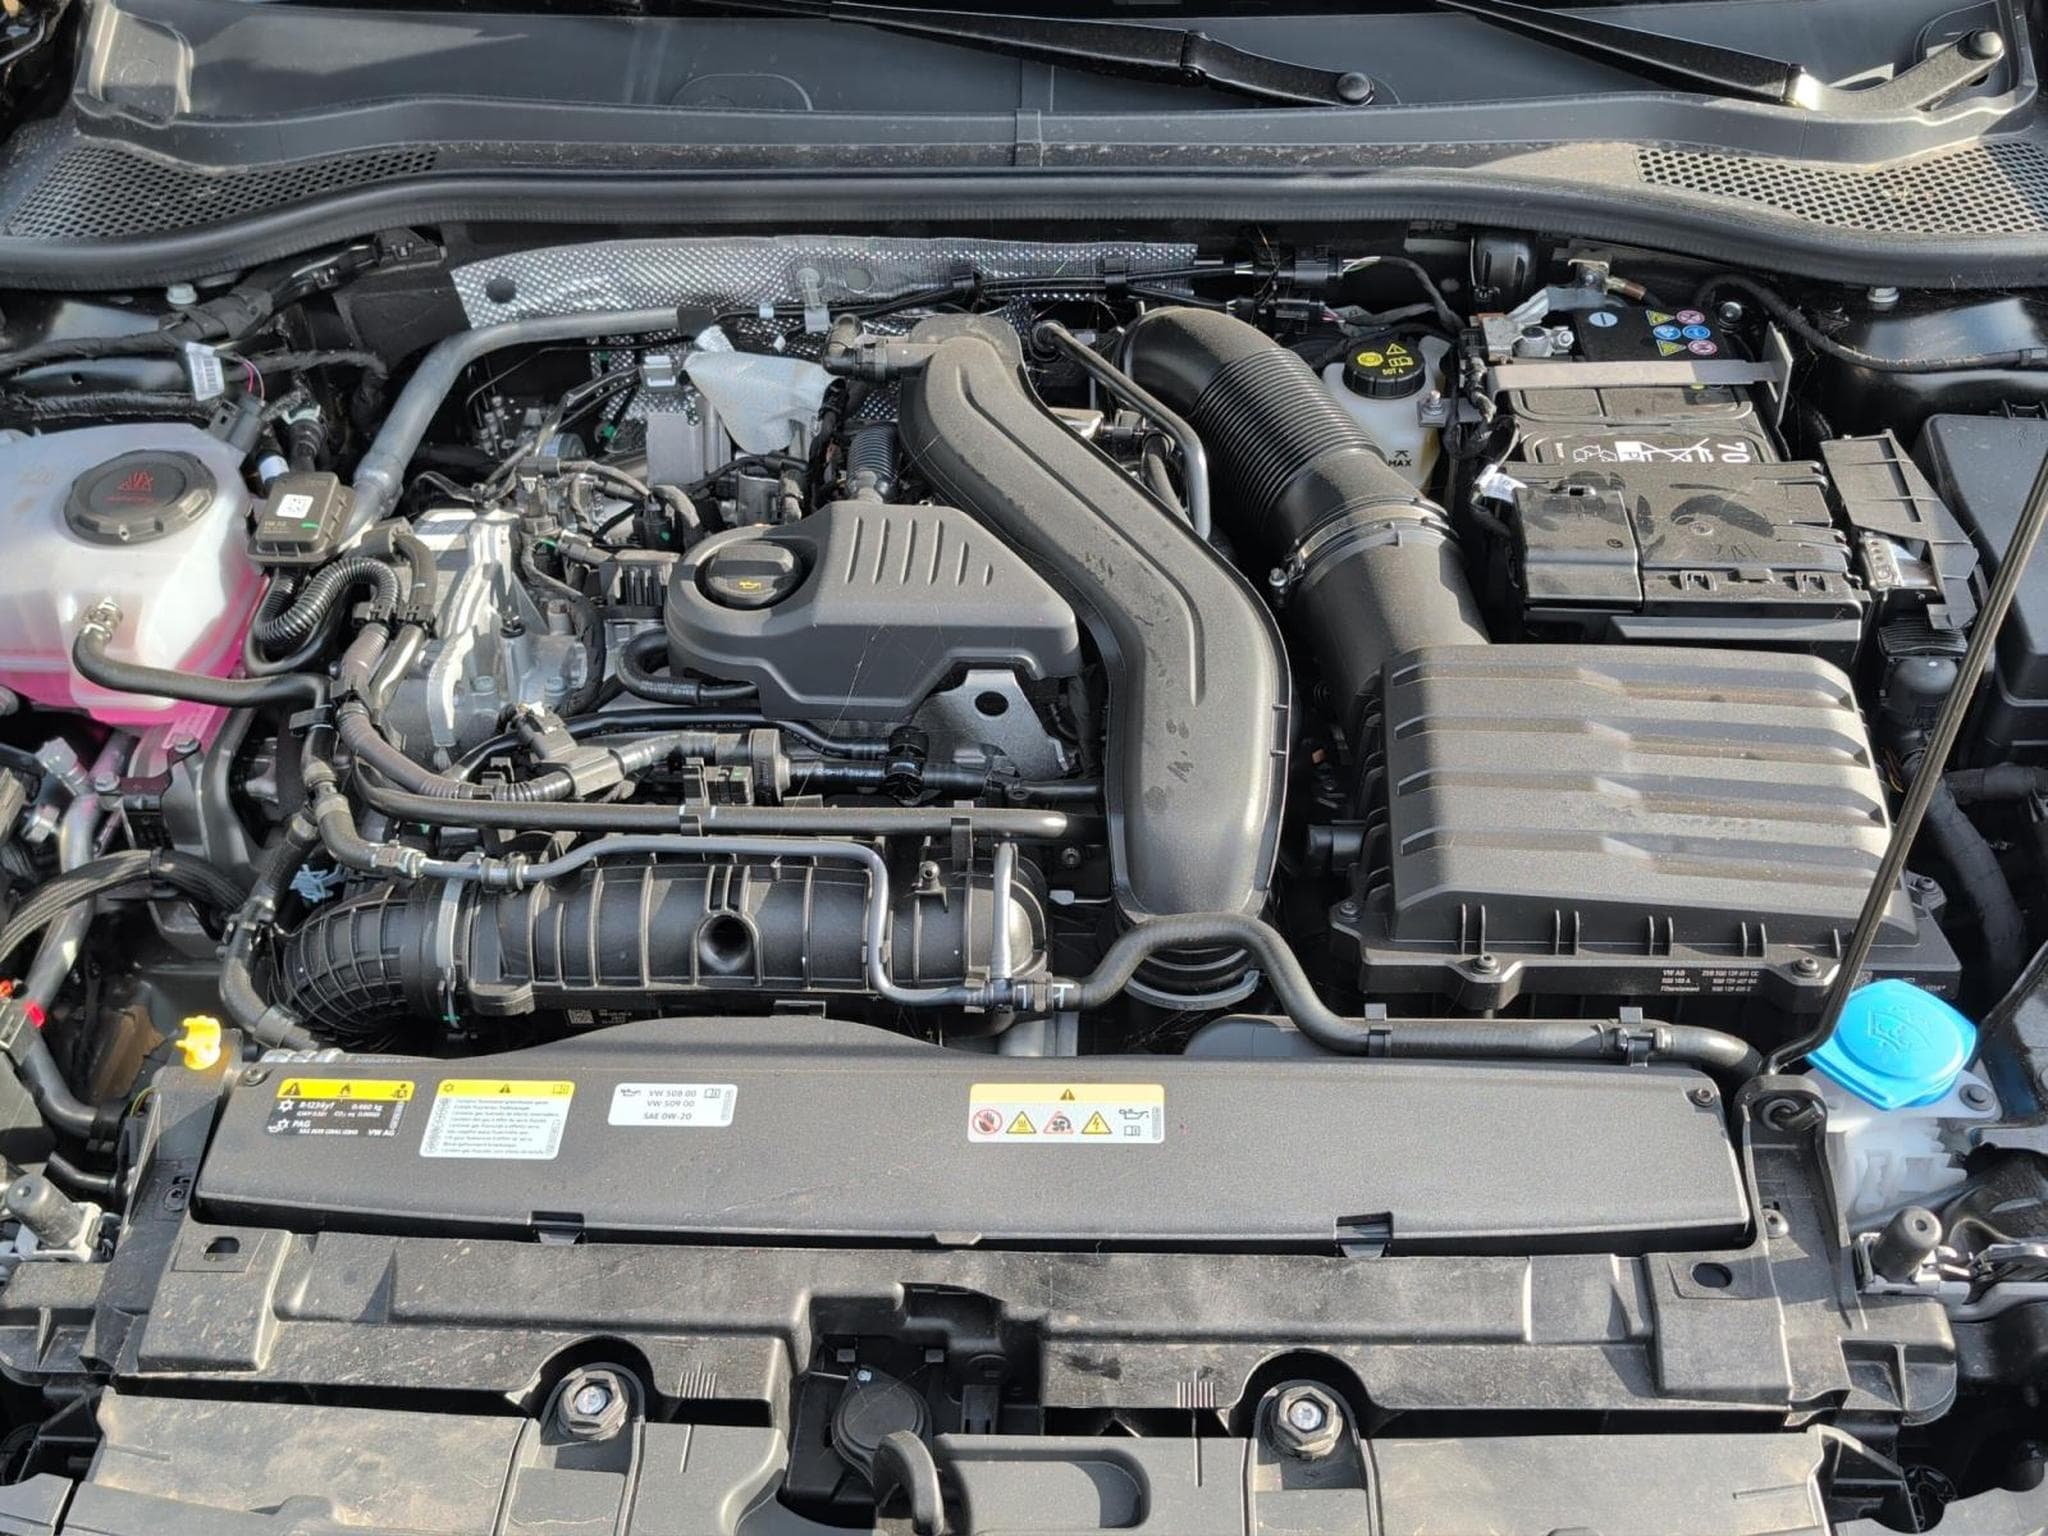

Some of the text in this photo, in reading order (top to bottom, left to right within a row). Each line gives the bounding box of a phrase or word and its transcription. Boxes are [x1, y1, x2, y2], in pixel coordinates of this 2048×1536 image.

[1717, 442, 1750, 463] 70
[1388, 459, 1412, 467] MAX
[649, 1089, 697, 1097] VW 508 00
[647, 1099, 696, 1107] VW 509 00
[644, 1112, 692, 1121] SAE 0W-20
[292, 1119, 312, 1128] PAG
[367, 1128, 382, 1136] VW
[382, 1129, 396, 1137] AG
